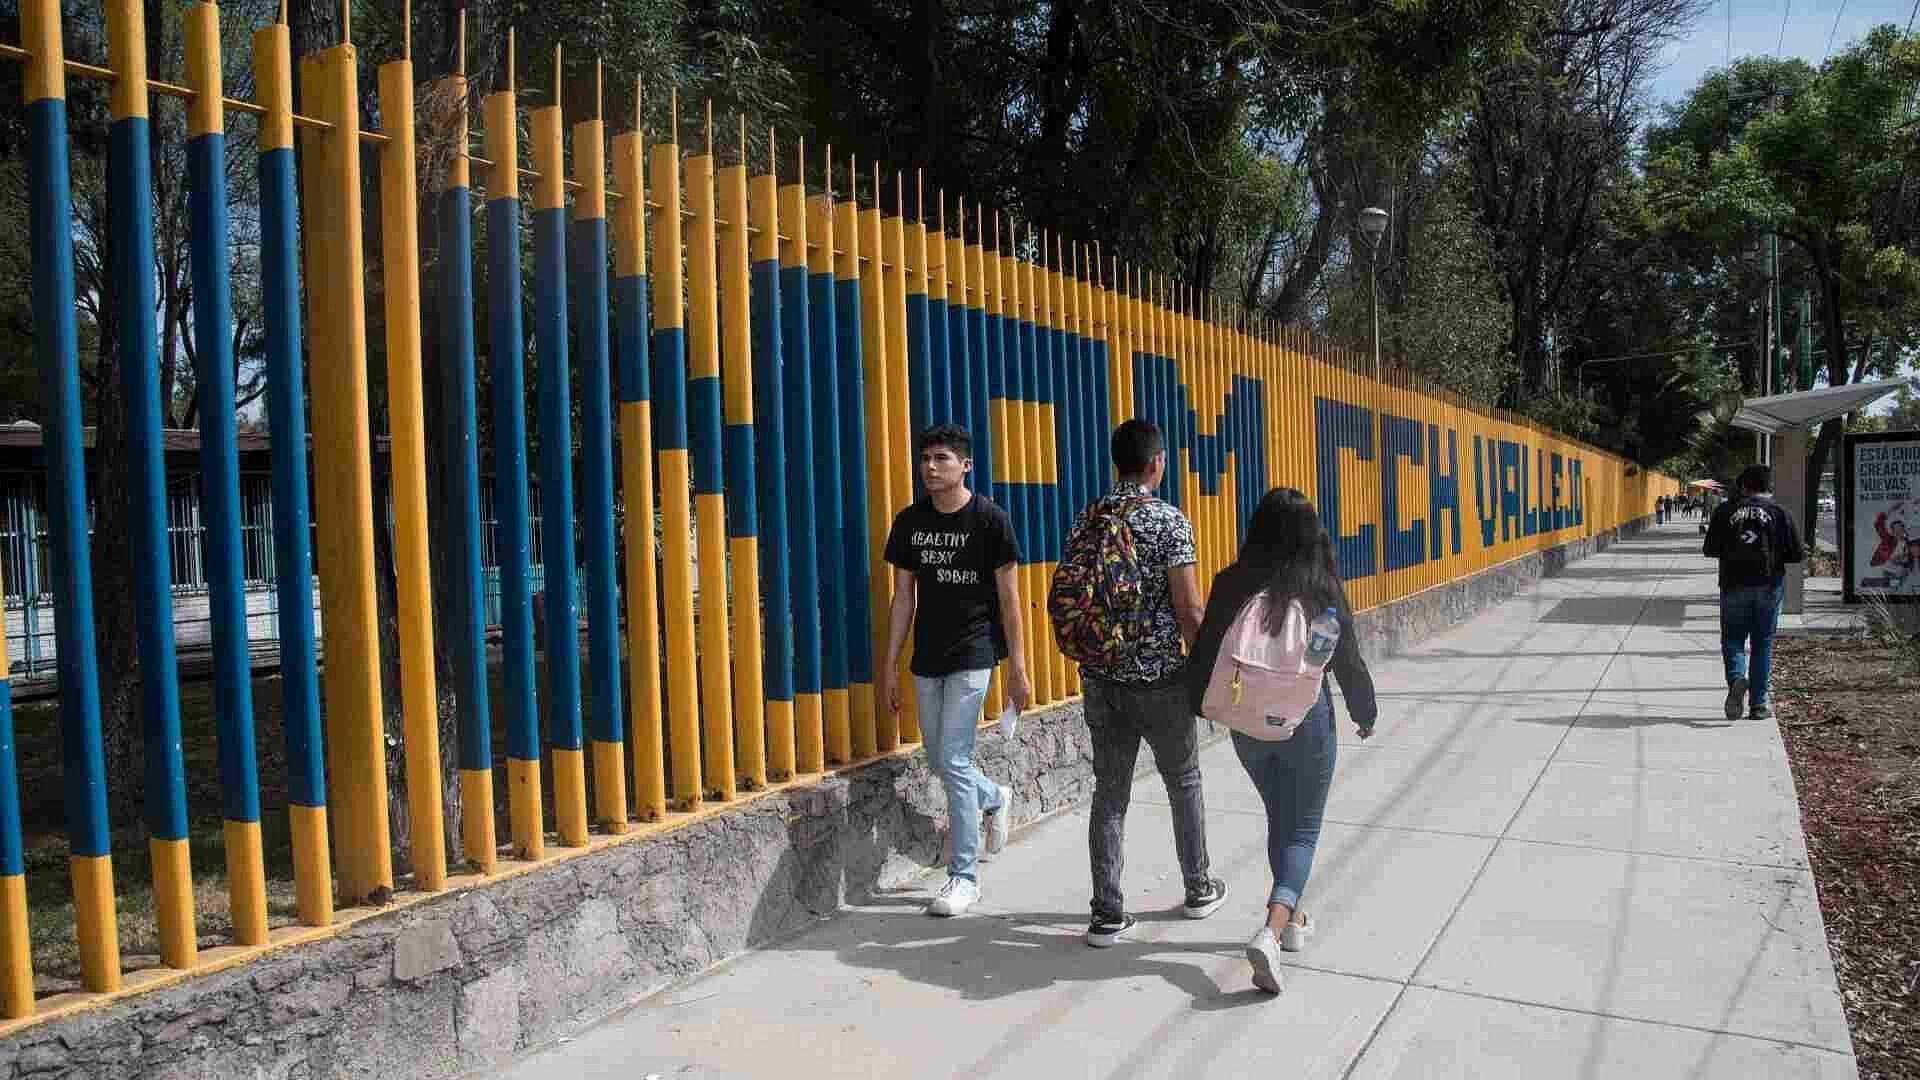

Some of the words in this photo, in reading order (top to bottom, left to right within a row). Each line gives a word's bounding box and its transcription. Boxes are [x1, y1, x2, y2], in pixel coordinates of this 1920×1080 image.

[1860, 462, 1900, 476] CREAR
[1313, 396, 1461, 581] CCH
[1473, 435, 1583, 547] VALLEJO
[911, 531, 970, 547] HEALTHY
[920, 550, 956, 565] SEXY
[937, 568, 980, 585] SOBER
